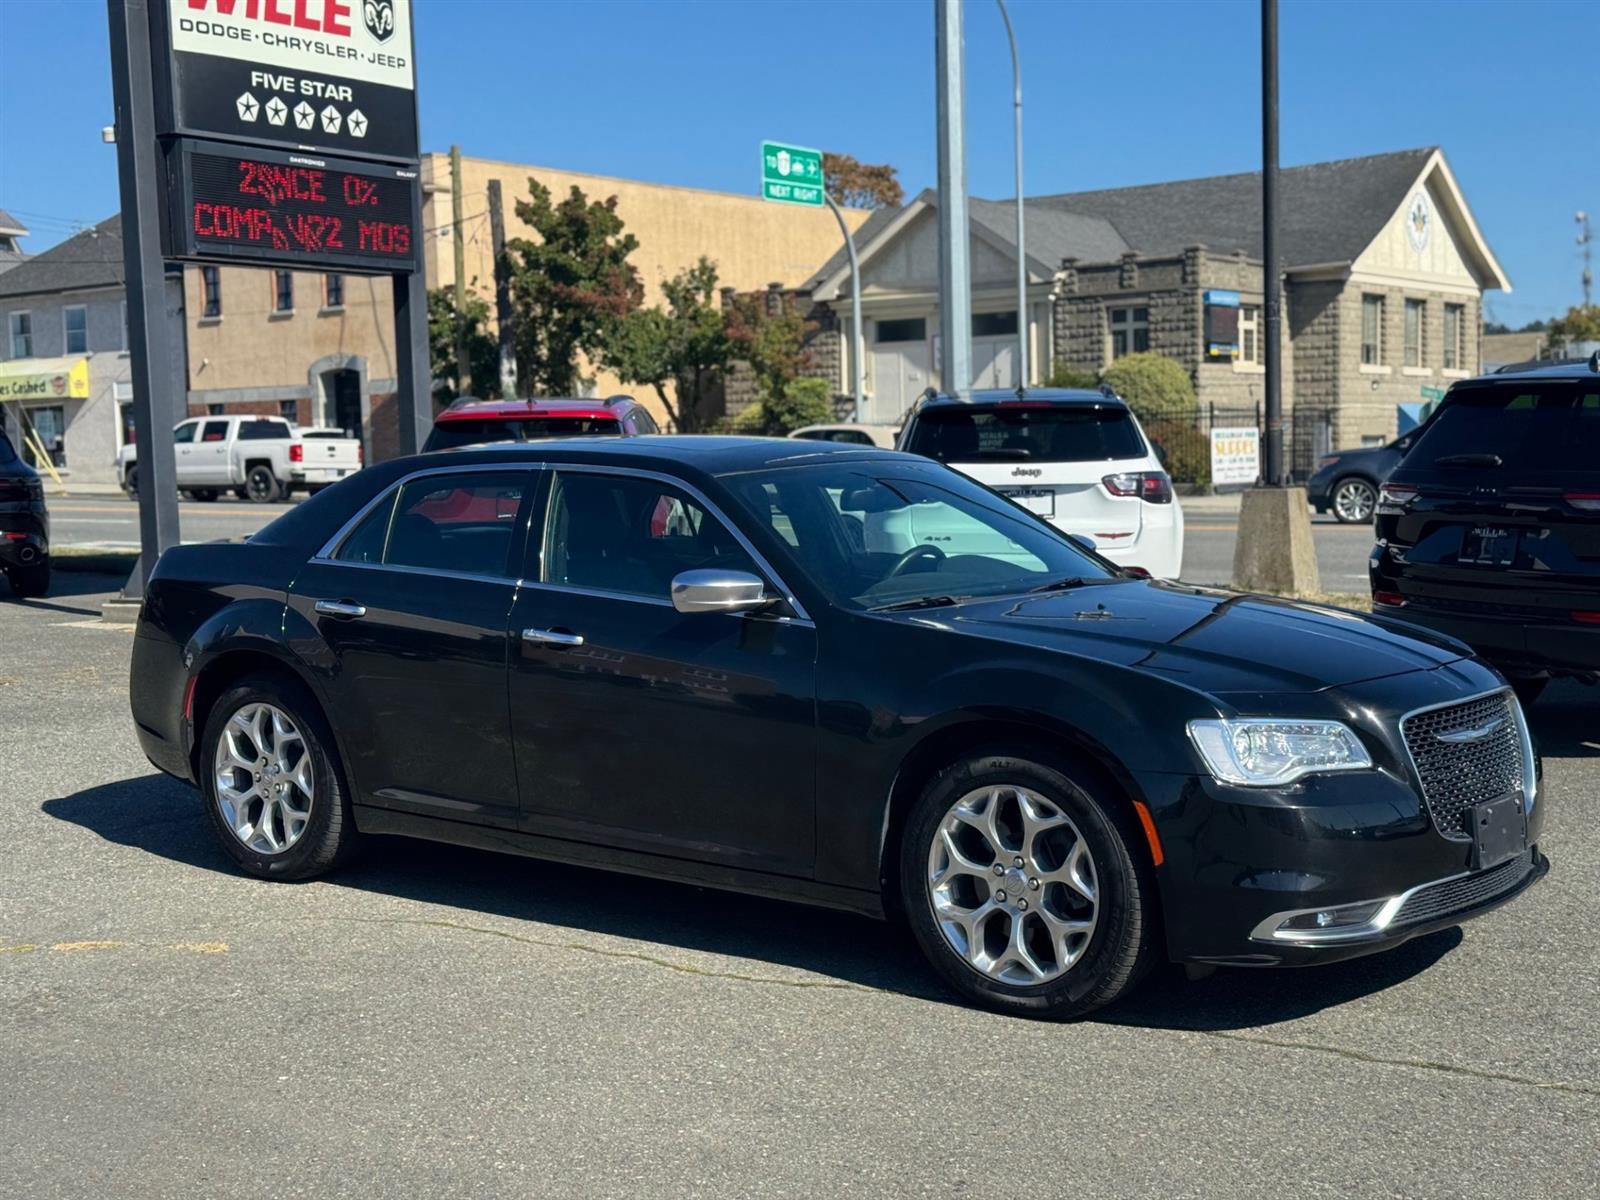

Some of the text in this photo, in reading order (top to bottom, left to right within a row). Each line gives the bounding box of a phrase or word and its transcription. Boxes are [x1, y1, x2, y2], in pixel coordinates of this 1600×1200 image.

[187, 0, 351, 37] LLE
[180, 18, 406, 69] DODGE CHRYSLER JEEP
[251, 71, 352, 102] FIVE STAR
[12, 381, 46, 394] Cashed
[1011, 467, 1042, 478] Jeep
